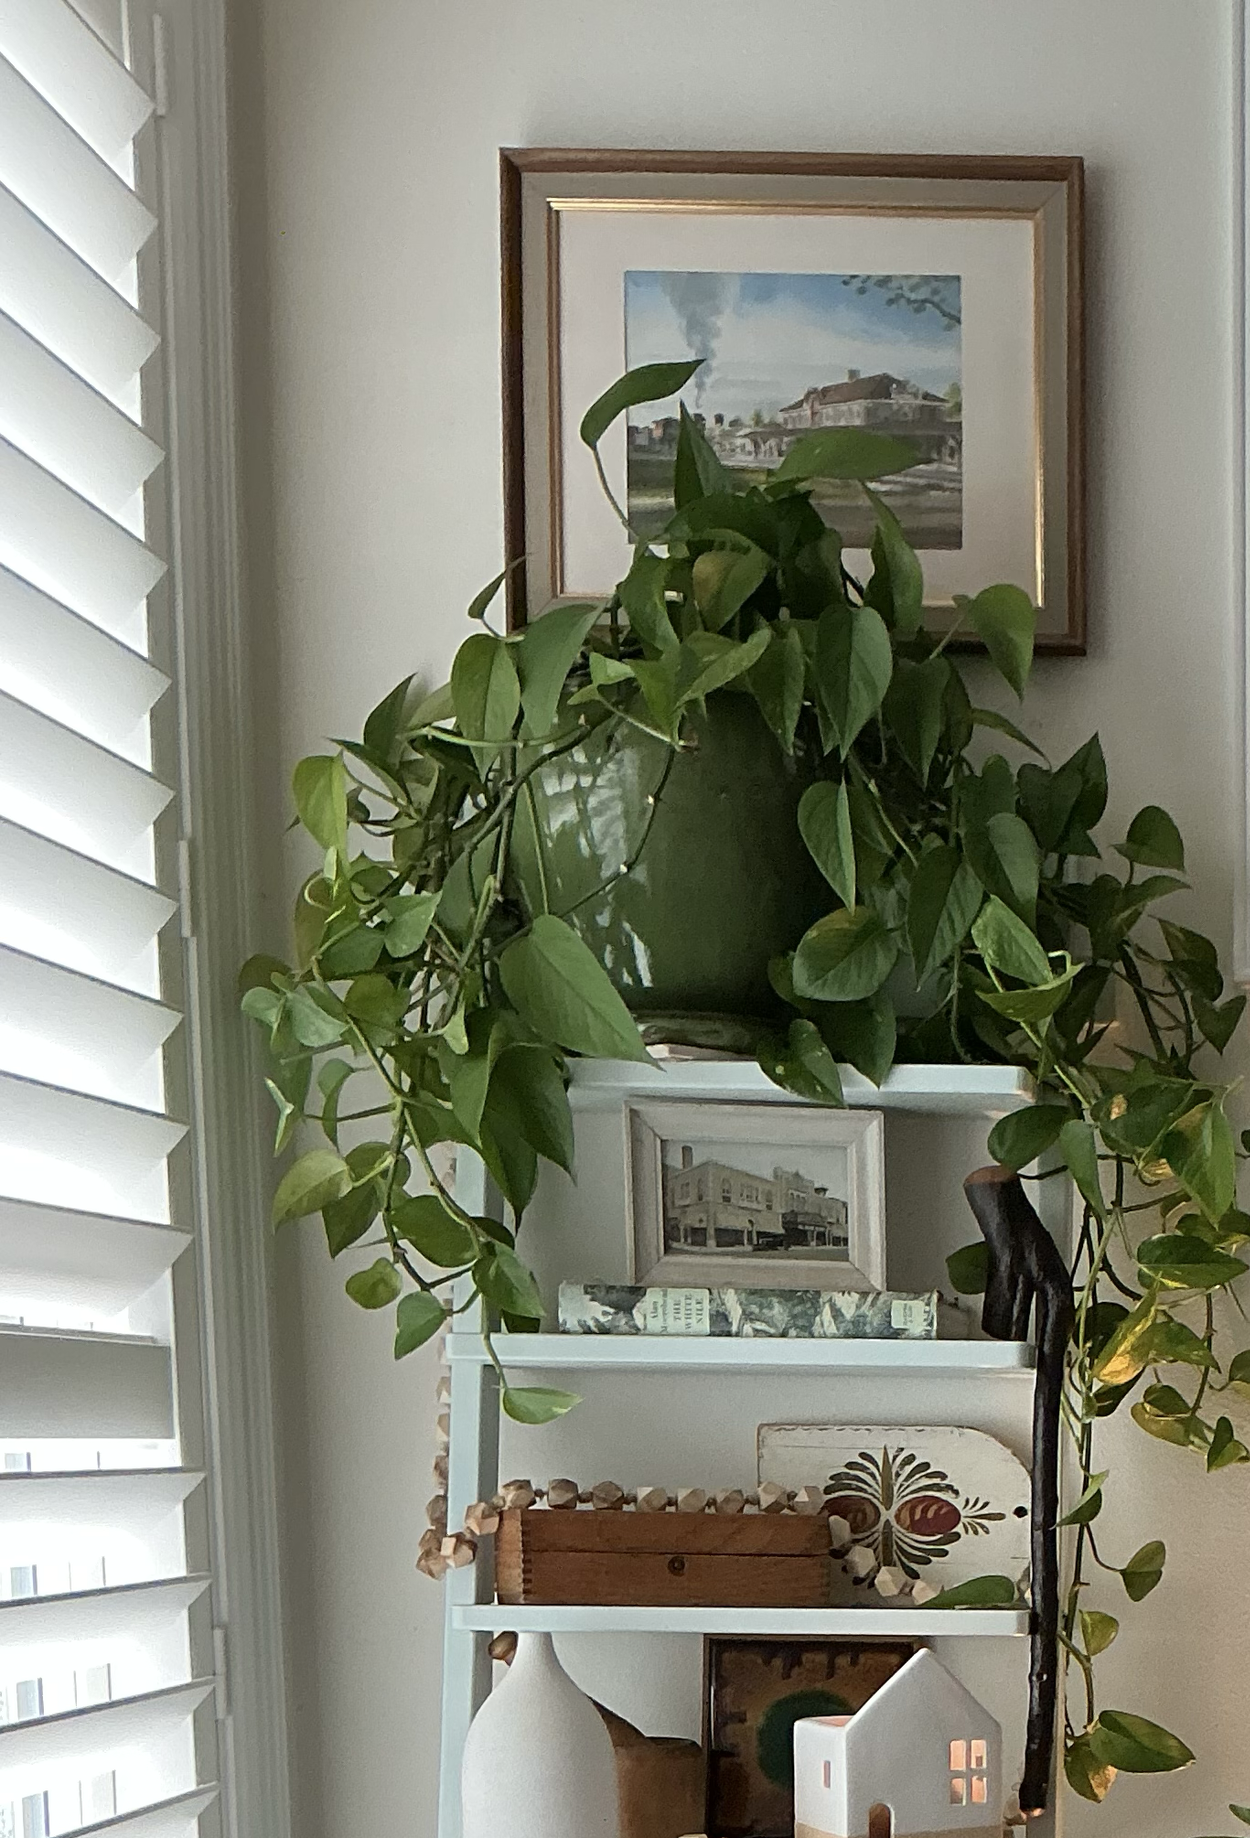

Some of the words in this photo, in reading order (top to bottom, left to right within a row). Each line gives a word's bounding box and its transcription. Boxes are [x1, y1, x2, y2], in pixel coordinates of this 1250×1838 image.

[673, 1300, 681, 1321] THE
[684, 1293, 692, 1329] WHITE
[695, 1298, 703, 1323] NILE
